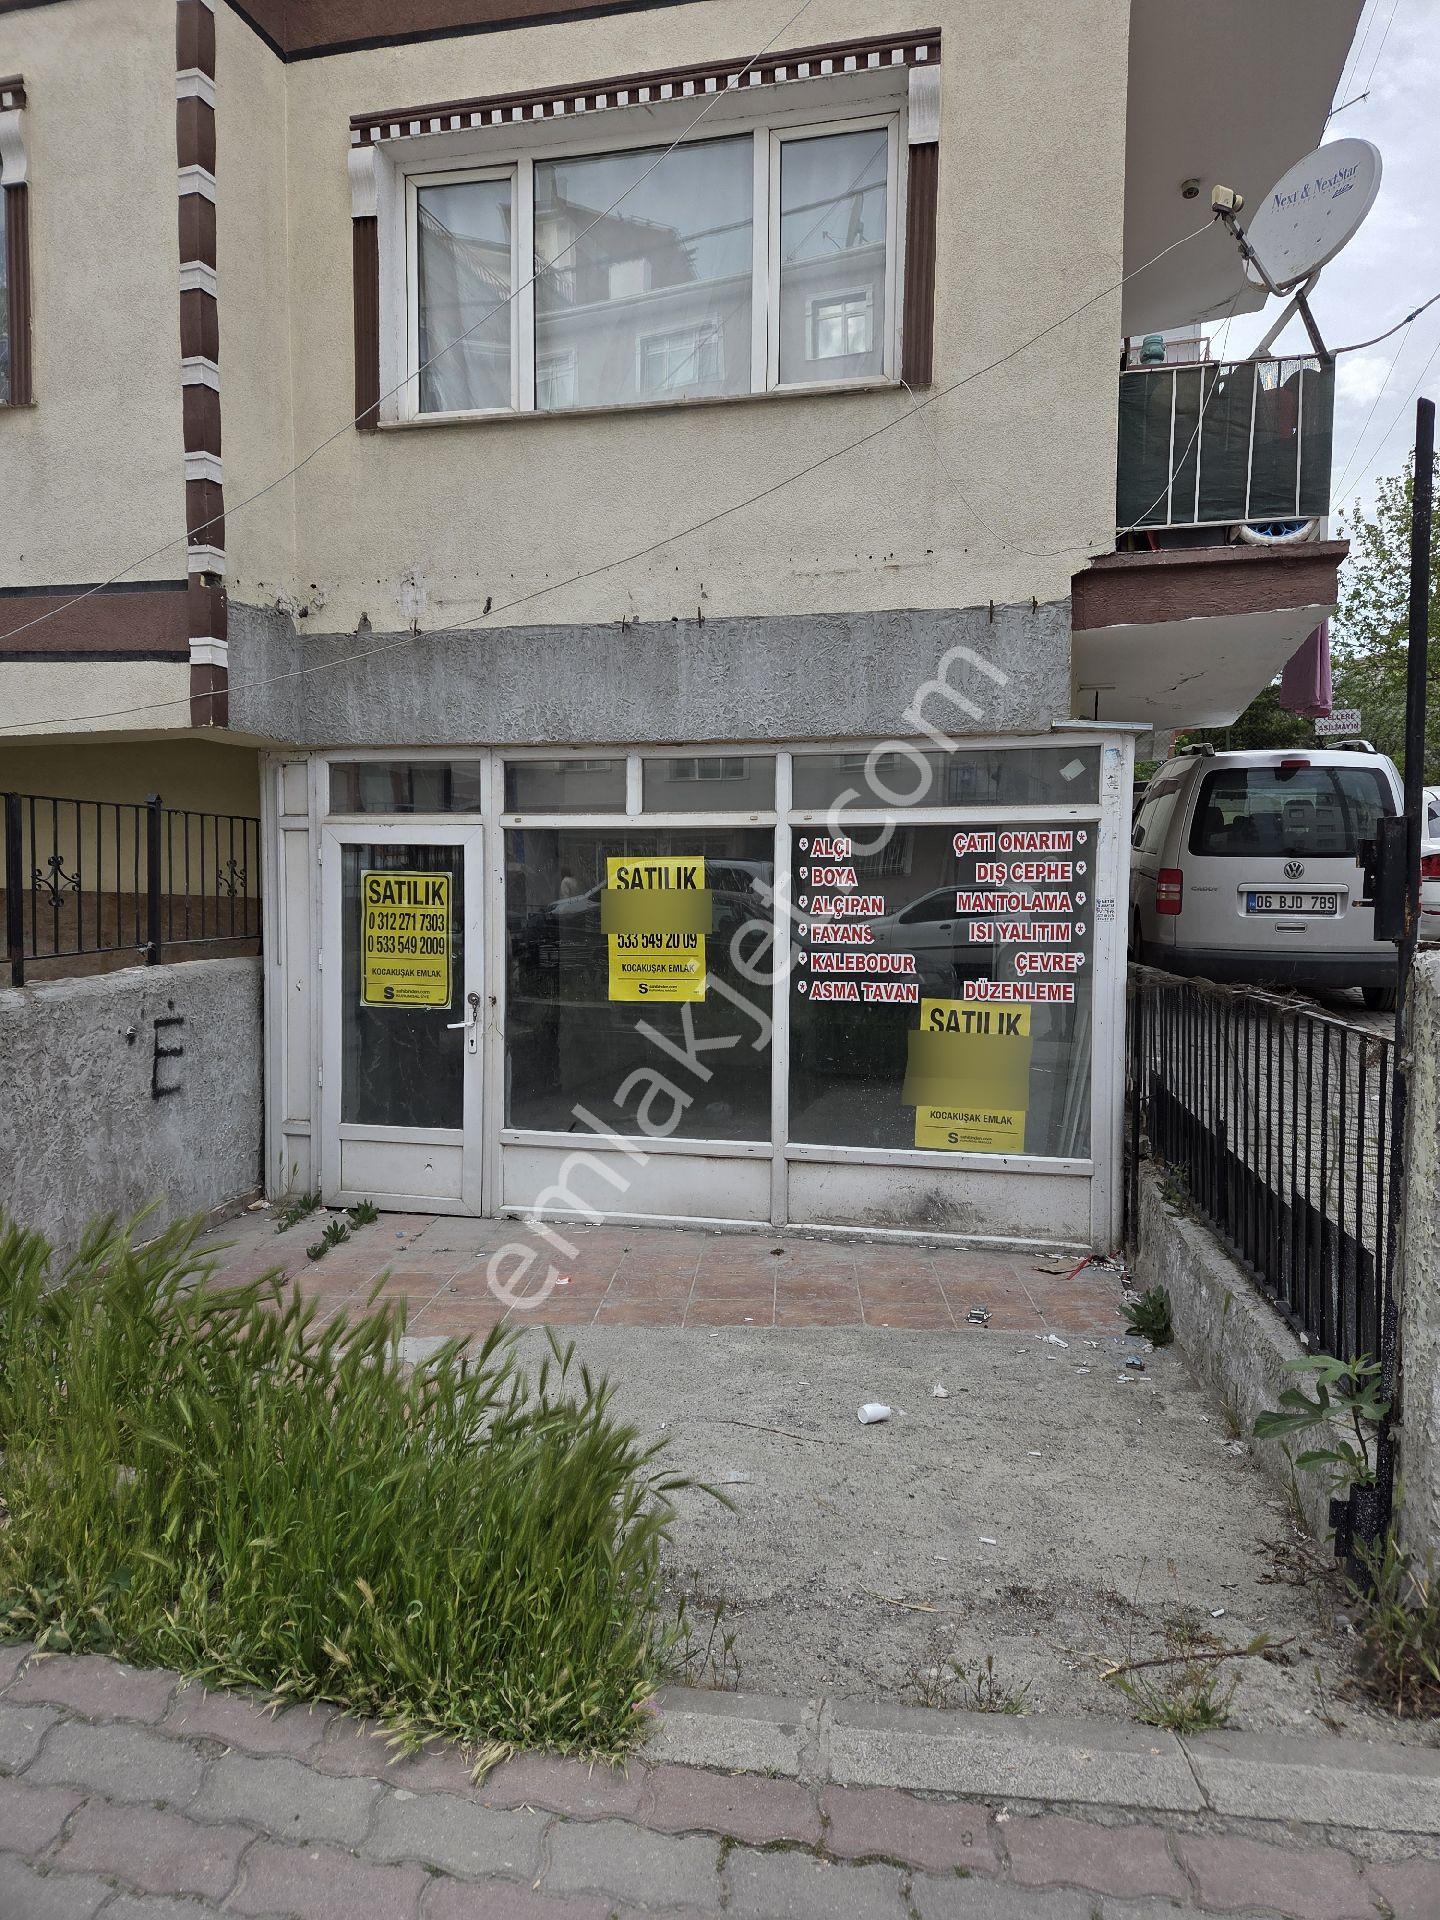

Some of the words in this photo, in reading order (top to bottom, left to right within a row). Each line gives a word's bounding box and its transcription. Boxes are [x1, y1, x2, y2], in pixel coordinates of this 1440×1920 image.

[1272, 192, 1298, 210] Next
[1300, 184, 1310, 200] &
[812, 839, 850, 860] ALÇI
[954, 833, 995, 856] ÇATI
[999, 832, 1072, 851] ONARIM
[617, 867, 697, 889] SATILIK
[812, 868, 857, 885] BOYA
[976, 863, 1006, 885] DIŞ
[1010, 863, 1072, 881] CEPHE
[369, 879, 445, 905] SATILIK
[811, 897, 883, 918] ALÇIPAN
[957, 893, 1072, 911] MANTOLAMA
[1256, 896, 1272, 908] 06
[1280, 896, 1302, 909] BJD
[1311, 896, 1334, 909] 789
[369, 912, 375, 930] 0
[378, 912, 397, 930] 312
[399, 913, 416, 931] 271
[420, 914, 445, 931] 7303
[617, 934, 638, 948] 533
[641, 934, 662, 948] 549
[812, 926, 874, 943] FAYANS
[970, 922, 993, 941] ISI
[998, 923, 1070, 941] YALITIM
[368, 935, 374, 952] 0
[377, 935, 395, 953] 533
[398, 936, 417, 954] 549
[420, 936, 445, 955] 2009
[372, 968, 414, 978] KOCAKUŞAK
[417, 970, 441, 978] EMLAK
[622, 964, 666, 973] KOCAKUŞAK
[669, 965, 695, 973] EMLAK
[812, 954, 915, 973] KALEBODUR
[1016, 953, 1076, 975] ÇEVRE
[810, 983, 859, 1000] ASMA
[862, 984, 918, 1002] TAVAN
[965, 979, 1074, 1002] DÜZENLEME
[152, 1016, 185, 1100] E
[930, 1110, 981, 1123] KOCAKUŞAK
[983, 1115, 1012, 1125] EMLAK
